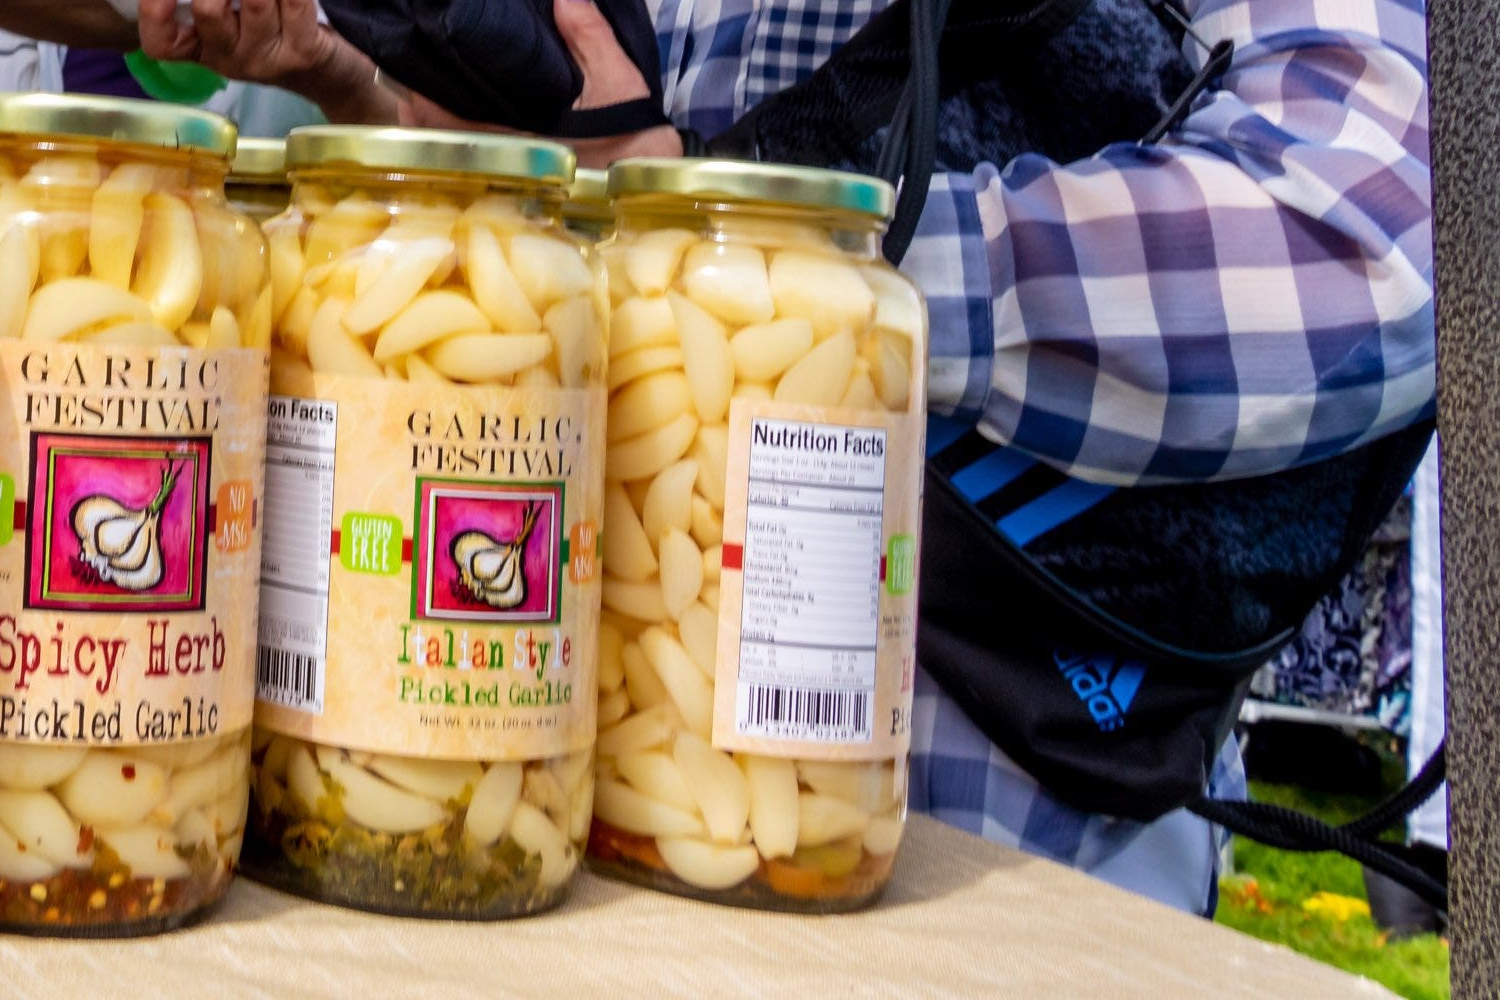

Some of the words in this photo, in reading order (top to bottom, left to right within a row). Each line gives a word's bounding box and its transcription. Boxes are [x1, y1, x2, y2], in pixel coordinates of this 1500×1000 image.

[20, 350, 220, 392] GARLIC
[290, 396, 335, 424] Facts
[407, 406, 572, 442] GARLIC
[753, 422, 838, 454] Nutrition
[843, 428, 885, 458] Facts
[229, 484, 246, 511] NO
[221, 519, 248, 545] MSG
[351, 518, 393, 540] GLUTEN
[578, 526, 593, 549] NO
[350, 536, 391, 573] FREE
[573, 555, 594, 578] MSG
[145, 617, 227, 678] Herb
[397, 623, 505, 671] Italian
[513, 627, 571, 681] Style
[398, 674, 499, 707] Pickled
[508, 679, 573, 708] Garlic
[135, 700, 219, 742] Garlic
